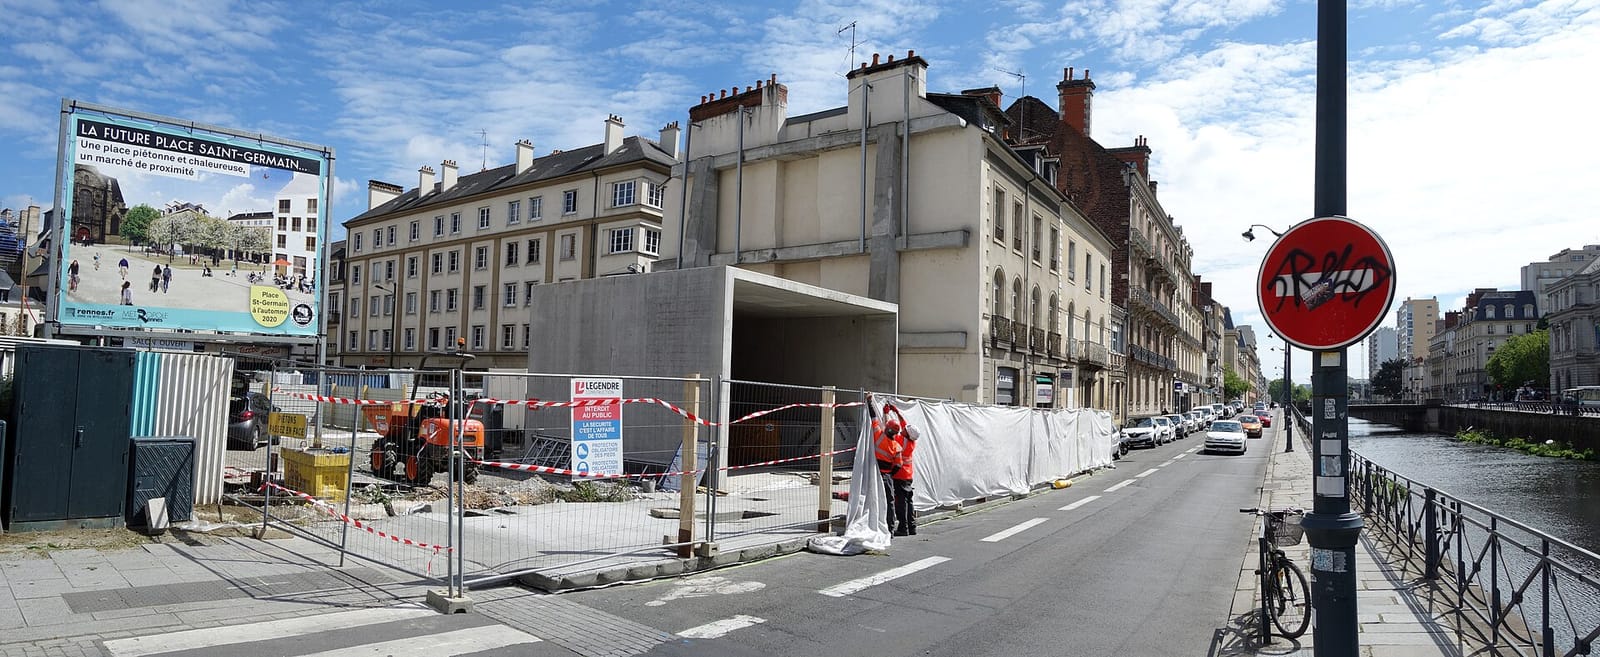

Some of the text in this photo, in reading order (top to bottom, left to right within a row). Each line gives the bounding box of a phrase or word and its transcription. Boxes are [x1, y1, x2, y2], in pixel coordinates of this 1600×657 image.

[81, 123, 308, 172] LA FUTURE PLACE SAINT-GERMAIN...
[80, 139, 246, 174] Une place piétonne et chaleureuse,
[80, 153, 195, 177] un marché de proximité
[261, 291, 279, 299] Place
[252, 299, 288, 307] St-Germain
[77, 308, 115, 317] rennes.fr
[257, 307, 287, 315] l'automne
[262, 315, 278, 323] 2020
[160, 339, 186, 347] OUVERT
[585, 381, 620, 390] LEGENDRE
